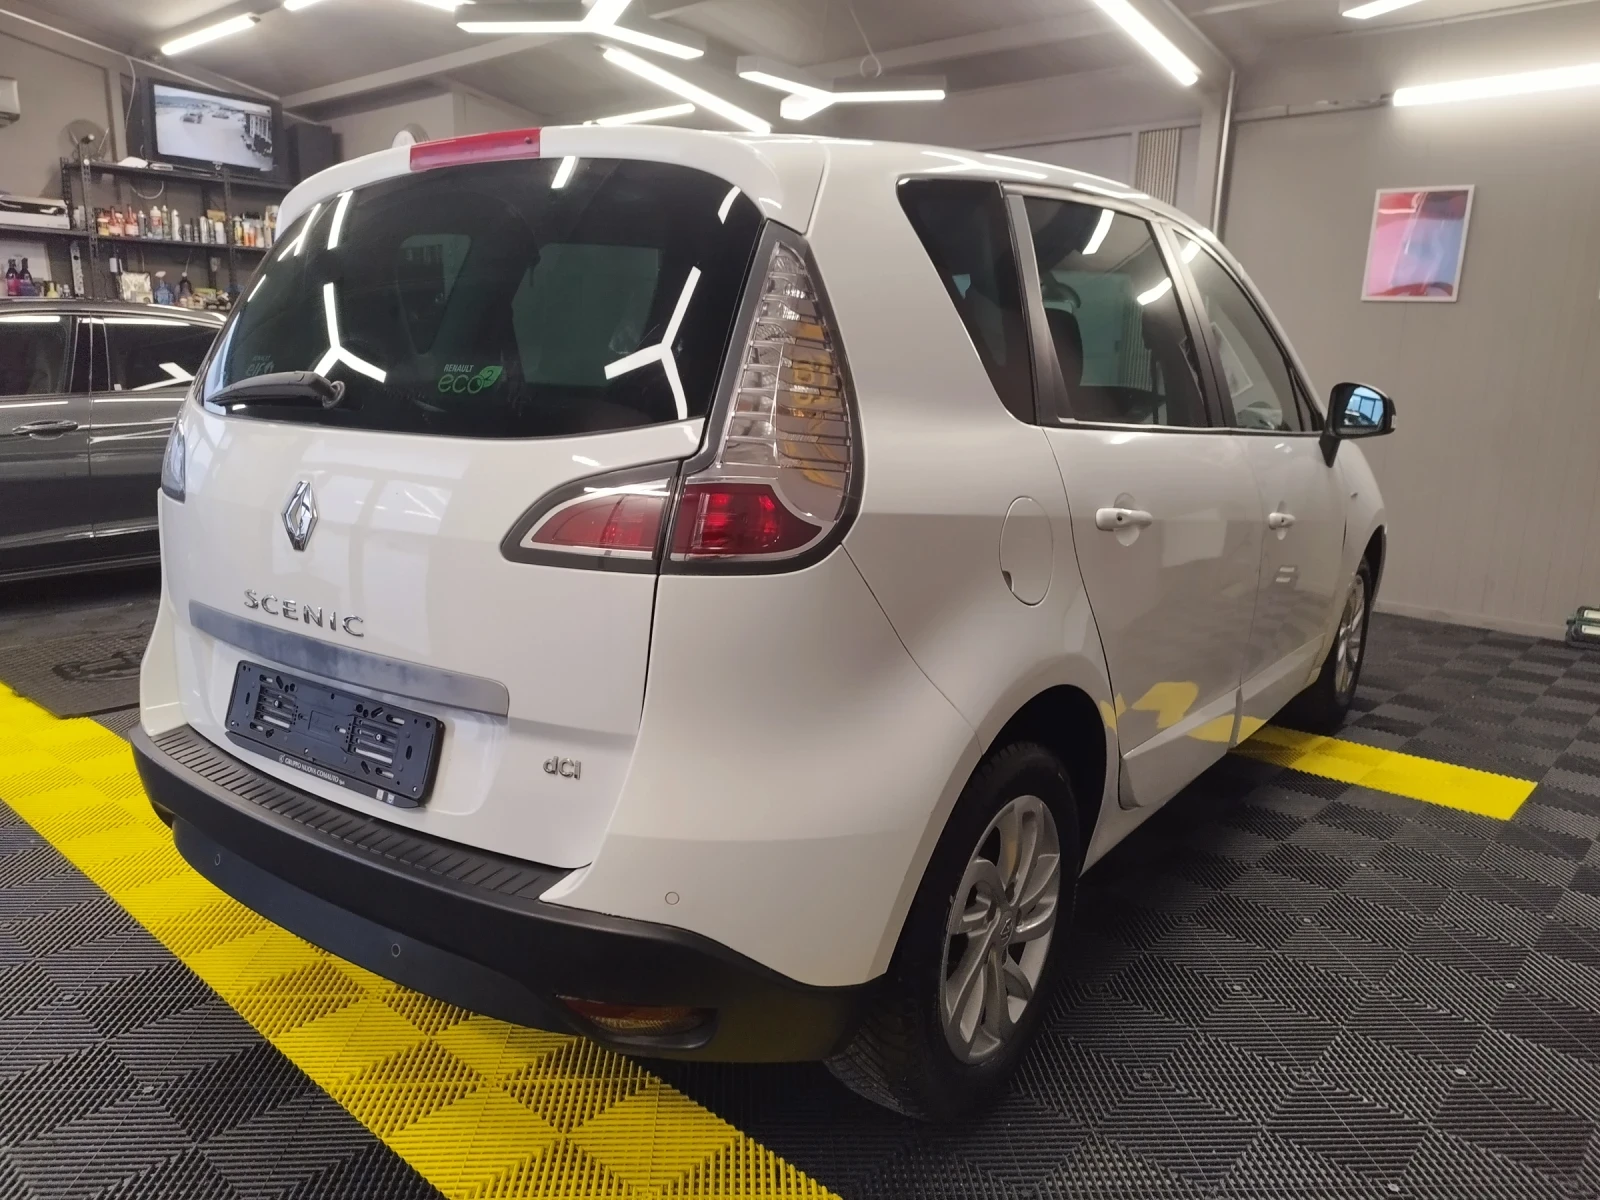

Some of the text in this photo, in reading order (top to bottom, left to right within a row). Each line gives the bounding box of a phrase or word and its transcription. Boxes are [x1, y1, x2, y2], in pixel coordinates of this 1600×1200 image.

[444, 364, 474, 373] RENAULT
[244, 589, 364, 637] SCENIC
[285, 758, 301, 769] GRUPPO
[302, 764, 316, 775] NUOVA
